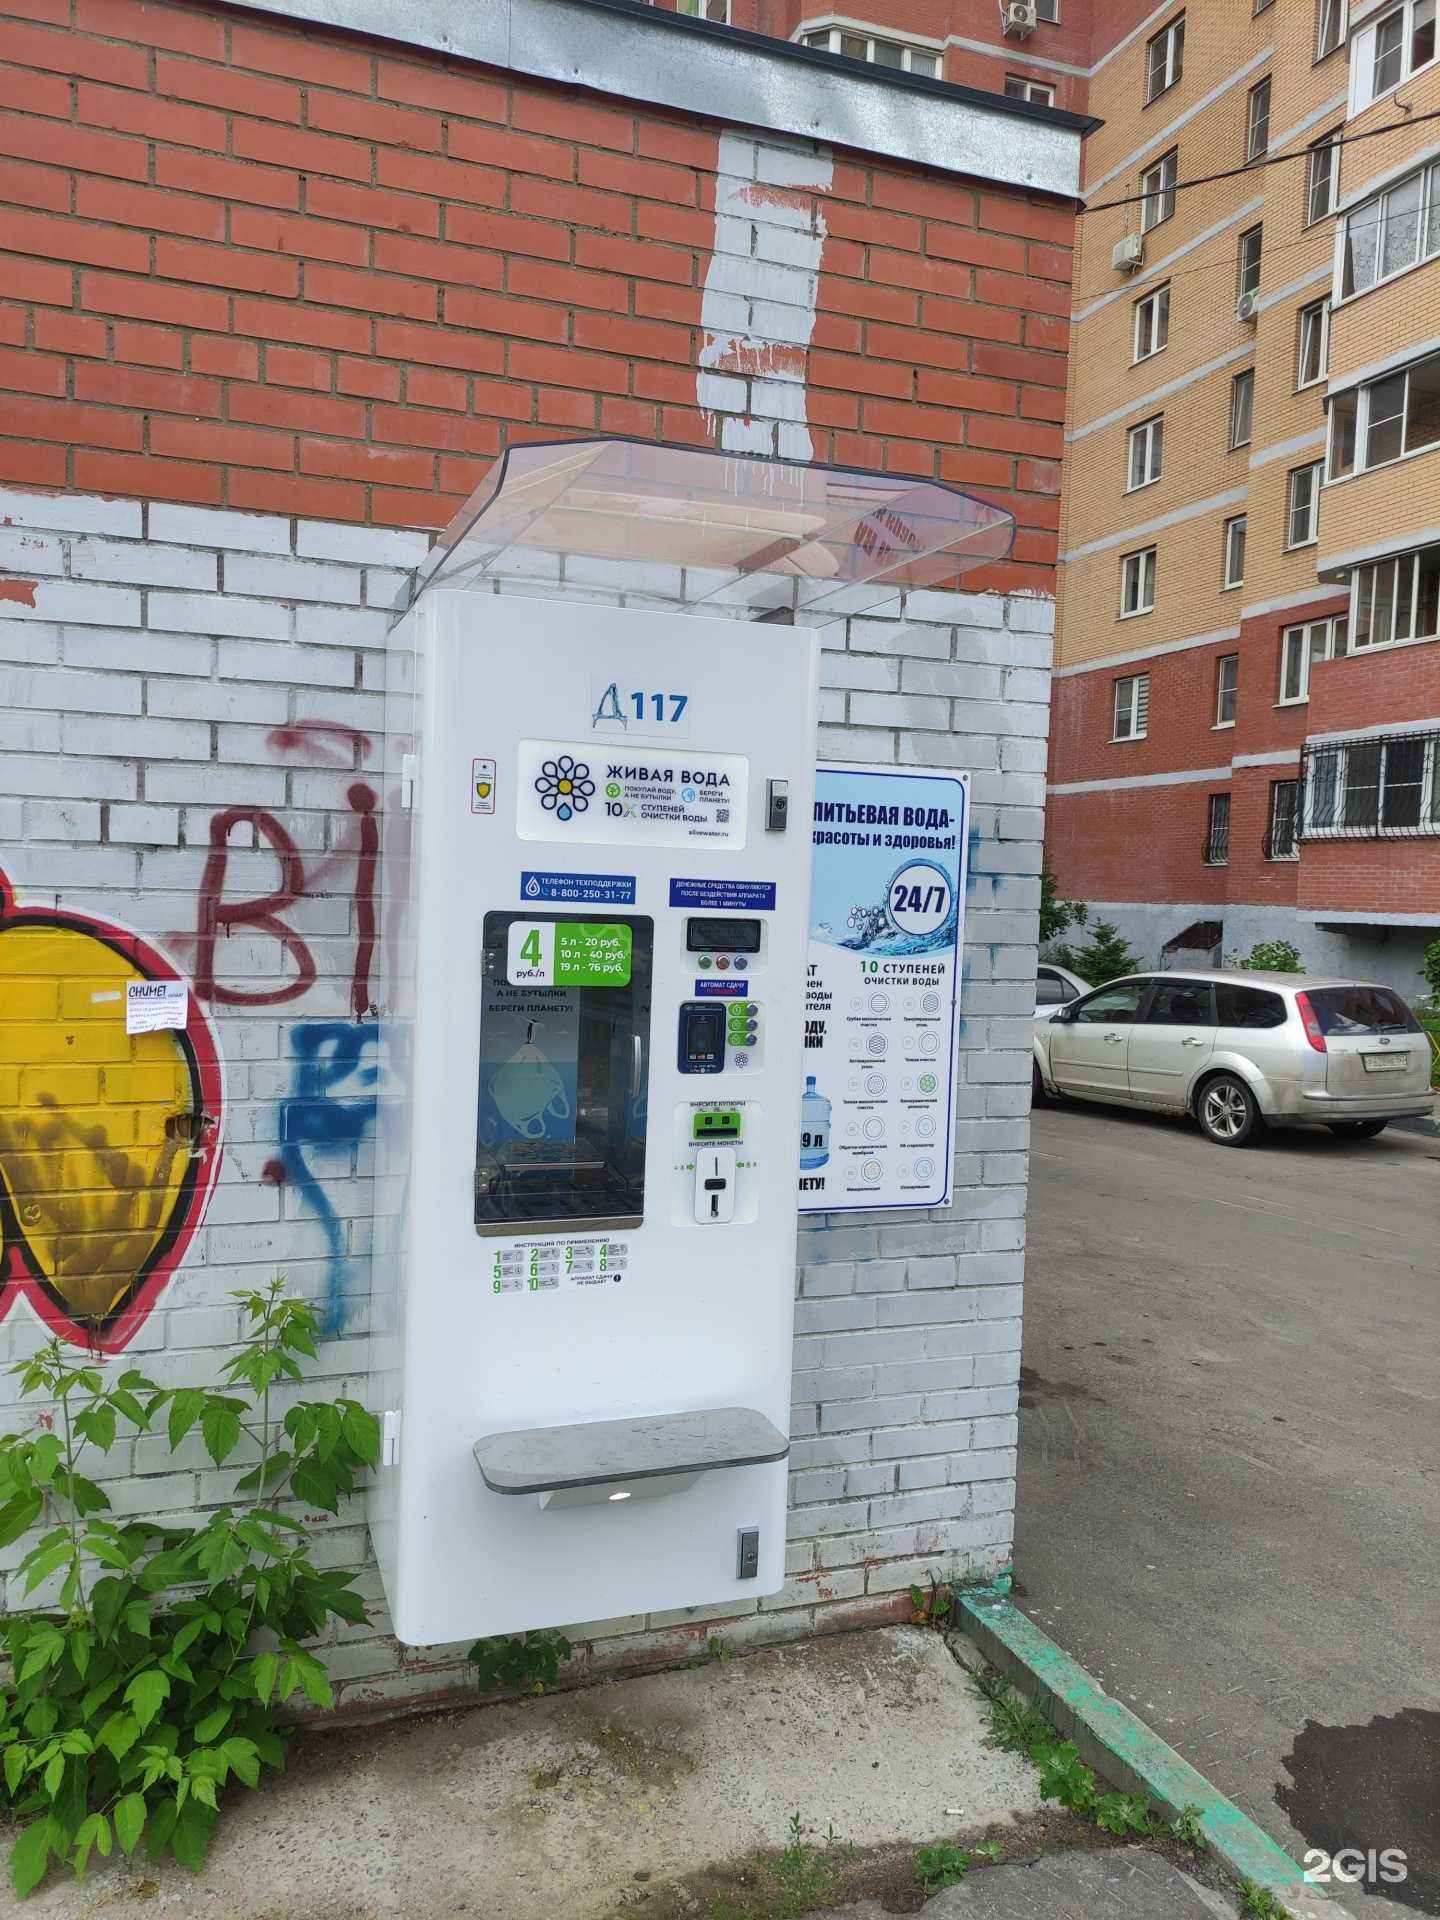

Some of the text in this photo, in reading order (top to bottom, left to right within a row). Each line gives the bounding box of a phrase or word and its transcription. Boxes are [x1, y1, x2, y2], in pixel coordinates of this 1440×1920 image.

[606, 765, 730, 787] ЖИВАЯ ВОДА
[624, 785, 656, 794] ПОКУПАЙ
[605, 802, 623, 817] 10
[641, 803, 685, 813] СТУПЕНЕЙ
[641, 812, 708, 823] ОЧИСТКИ ВОДЫ
[813, 802, 955, 830] ПИТЬЕВАЯ ВОДА-
[873, 835, 881, 846] и
[885, 834, 955, 850] здоровья!
[575, 880, 632, 888] ТЕХПОДДЕРЖКИ
[551, 888, 631, 900] 8-800-250-31-77
[893, 885, 946, 913] 24/7
[520, 929, 543, 968] 4
[561, 938, 567, 946] 5
[585, 937, 598, 946] 20
[600, 937, 621, 948] руб.
[560, 949, 571, 958] 10
[589, 950, 602, 959] 40
[605, 950, 626, 961] руб.
[516, 968, 545, 979] руб./л
[560, 962, 570, 971] 19
[588, 963, 601, 971] 76
[602, 962, 624, 973] руб.
[859, 960, 946, 974] 10 СТУПЕНЕЙ
[864, 976, 940, 986] ОЧИСТКИ ВОДЫ
[488, 1004, 525, 1012] БЕРЕГИ
[494, 1250, 501, 1264] 1
[530, 1248, 539, 1262] 2
[565, 1246, 573, 1260] 3
[599, 1244, 607, 1257] 4
[530, 1263, 538, 1276] 6
[565, 1261, 573, 1274] 7
[599, 1258, 607, 1271] 8
[493, 1265, 501, 1279] 5
[493, 1280, 501, 1294] 9
[527, 1278, 539, 1292] 10
